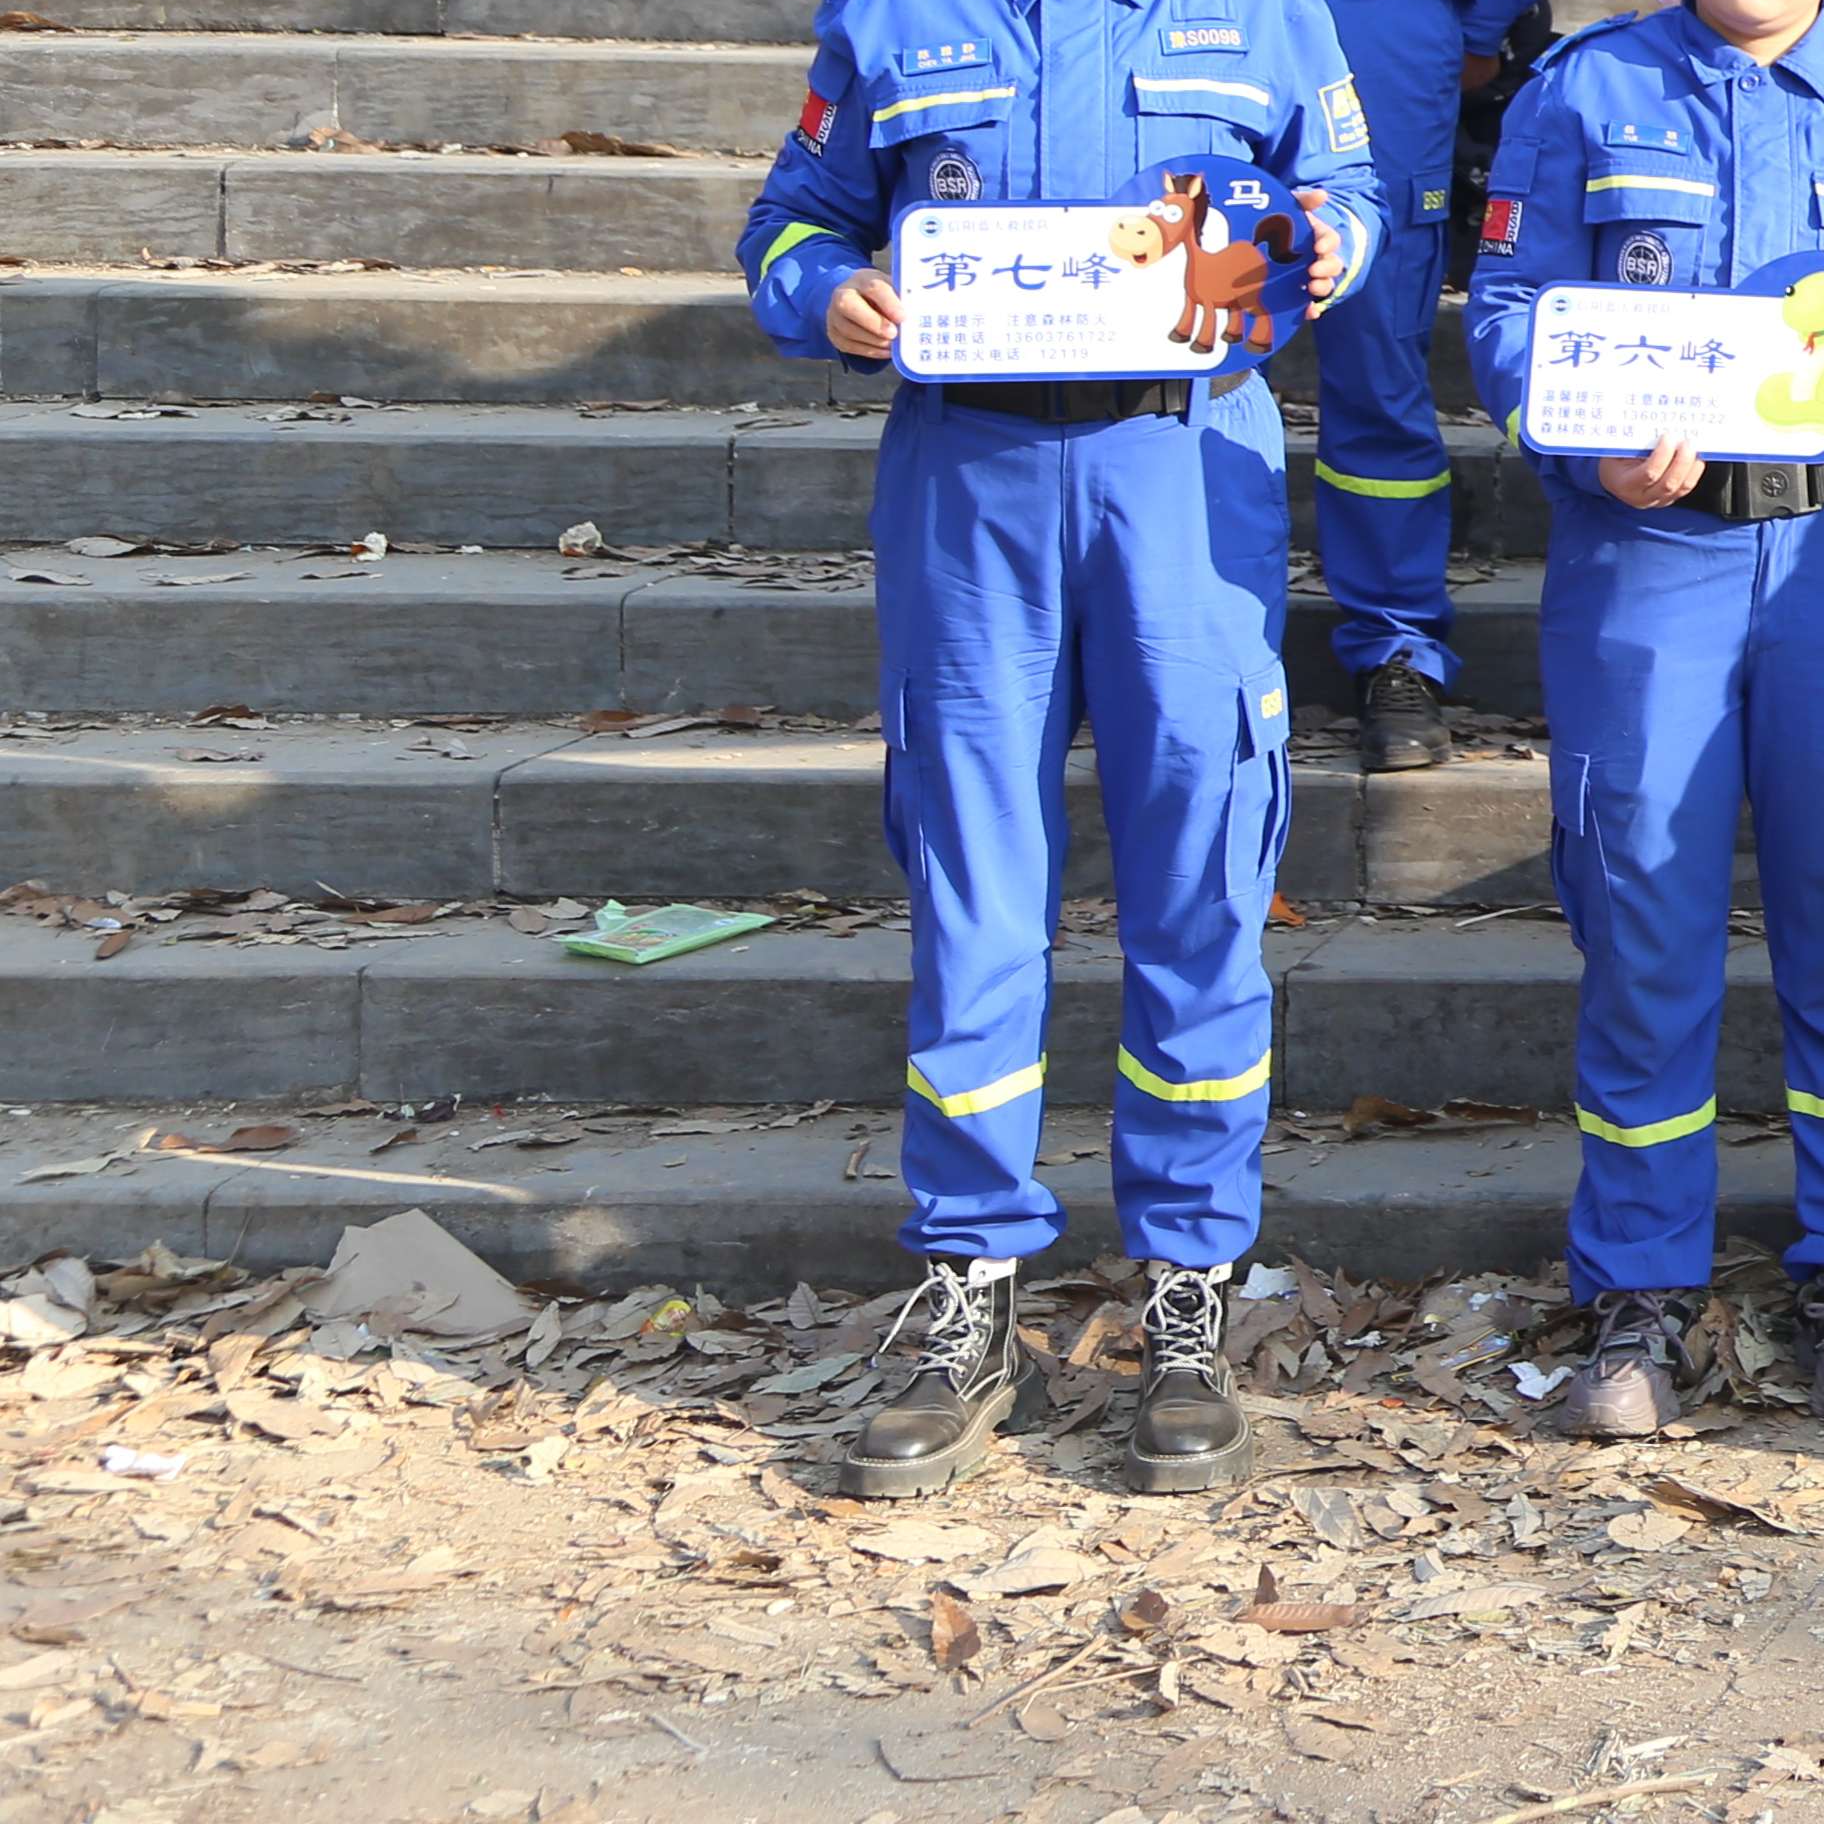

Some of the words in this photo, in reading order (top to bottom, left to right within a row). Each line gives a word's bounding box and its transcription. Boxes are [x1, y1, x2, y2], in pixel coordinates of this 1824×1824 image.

[936, 176, 968, 194] BSR
[1224, 179, 1271, 210] 马
[920, 251, 1121, 292] 第七峰
[1627, 256, 1657, 277] BSR
[1548, 330, 1735, 374] 第六峰
